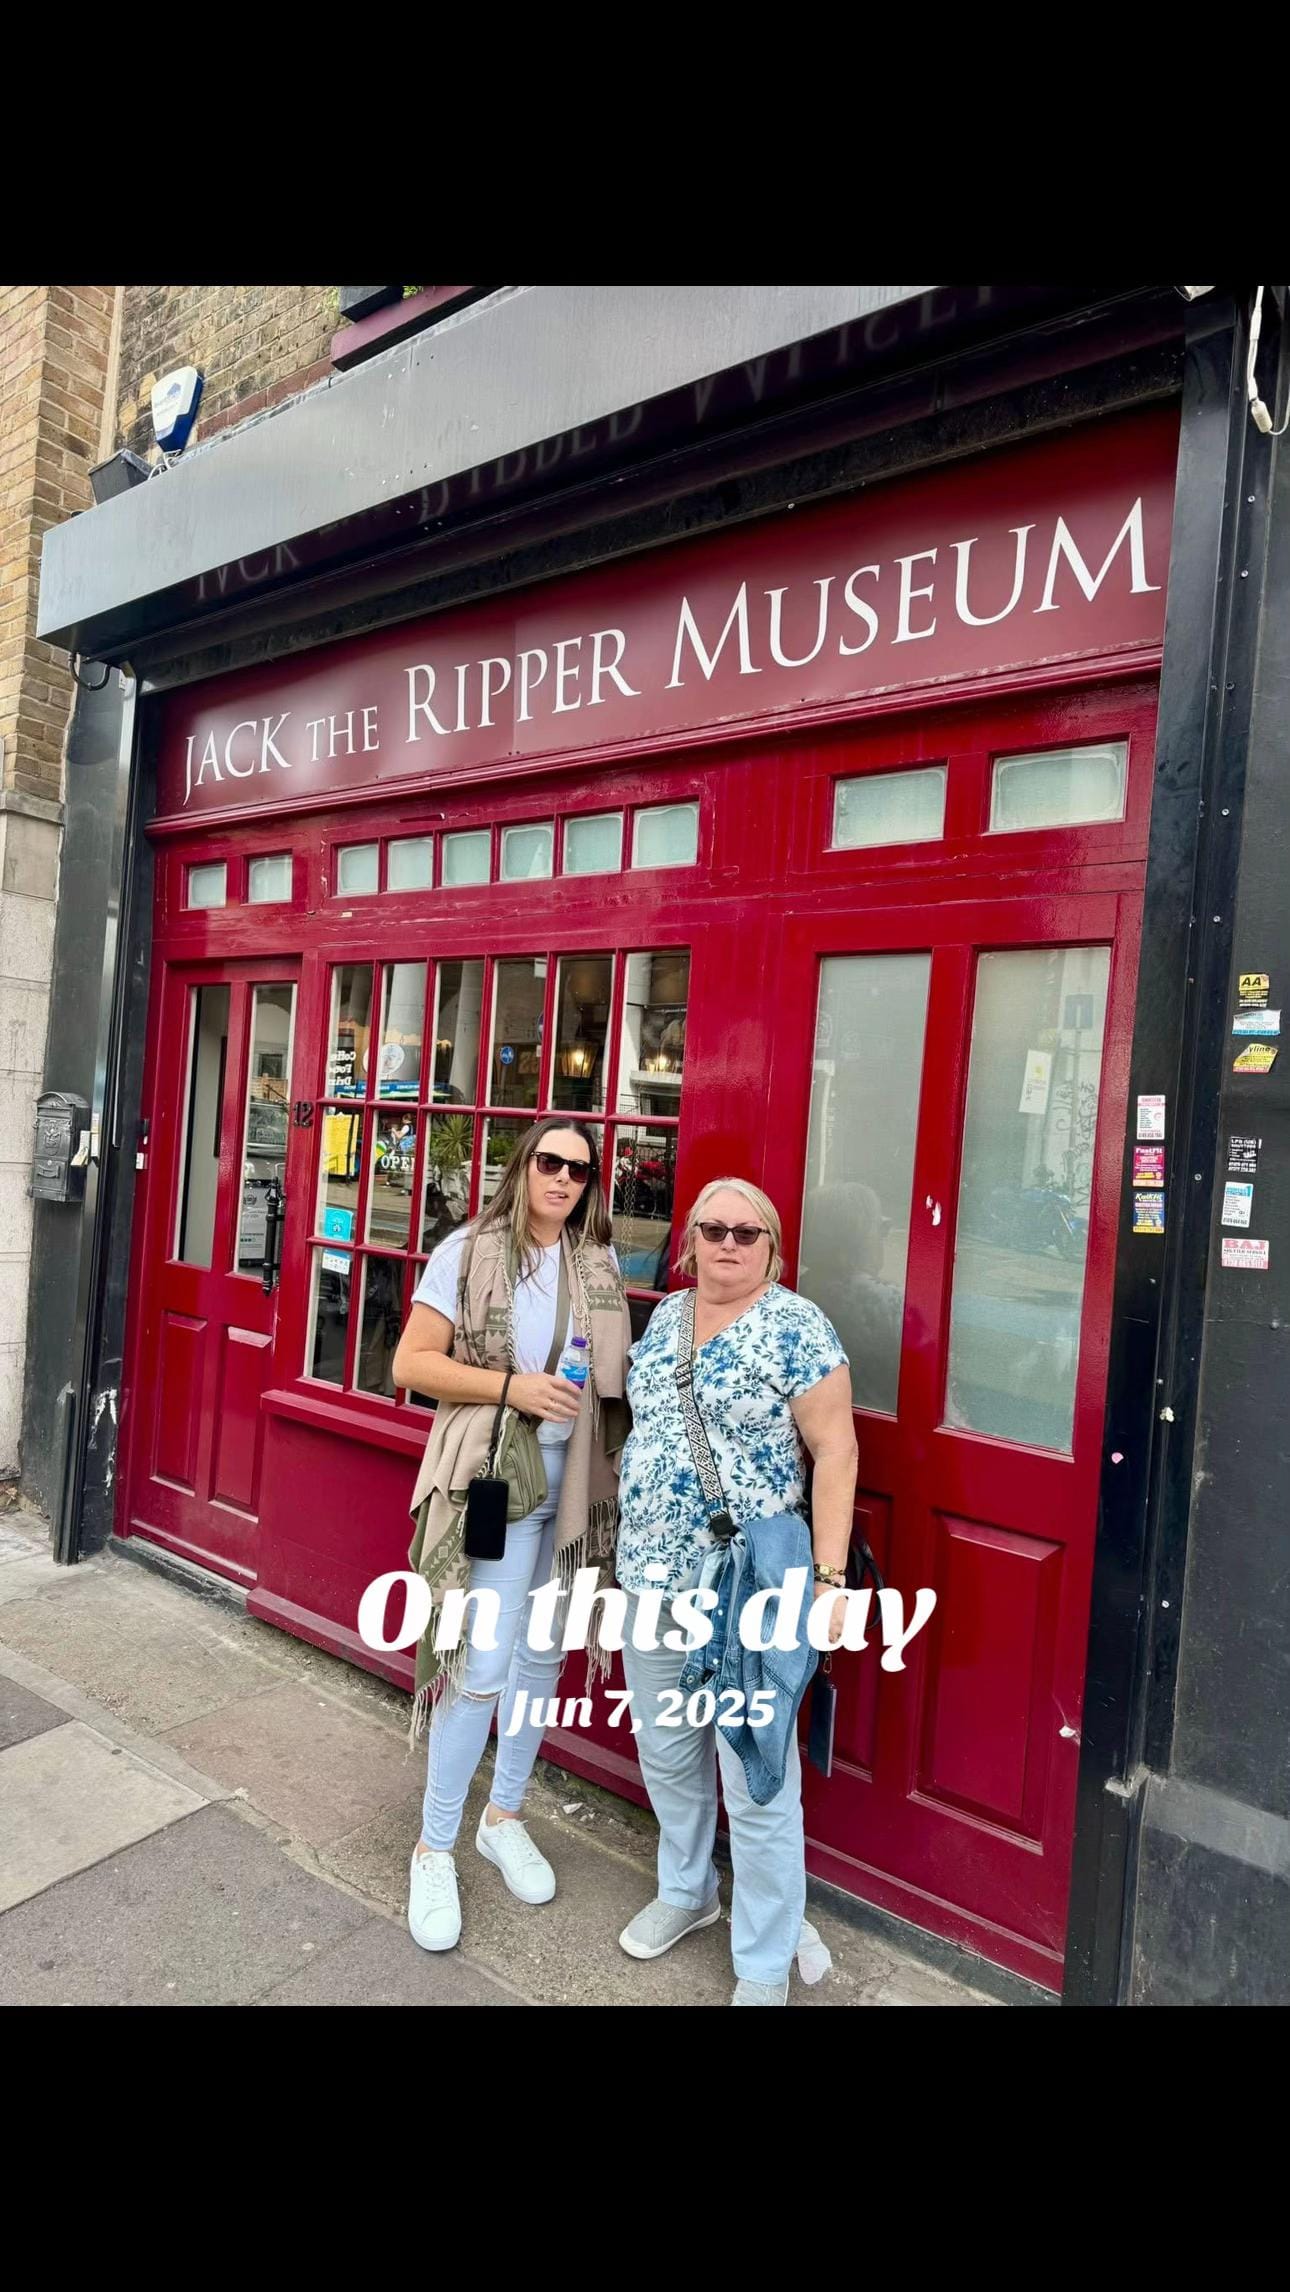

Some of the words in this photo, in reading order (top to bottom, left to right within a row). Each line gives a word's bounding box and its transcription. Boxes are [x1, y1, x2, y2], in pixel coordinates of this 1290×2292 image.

[182, 711, 292, 806] JACK
[305, 705, 381, 763] THE
[404, 628, 642, 744] RIPPER
[664, 496, 1163, 689] MUSEUM
[1241, 976, 1262, 986] AA
[294, 1101, 314, 1128] 12
